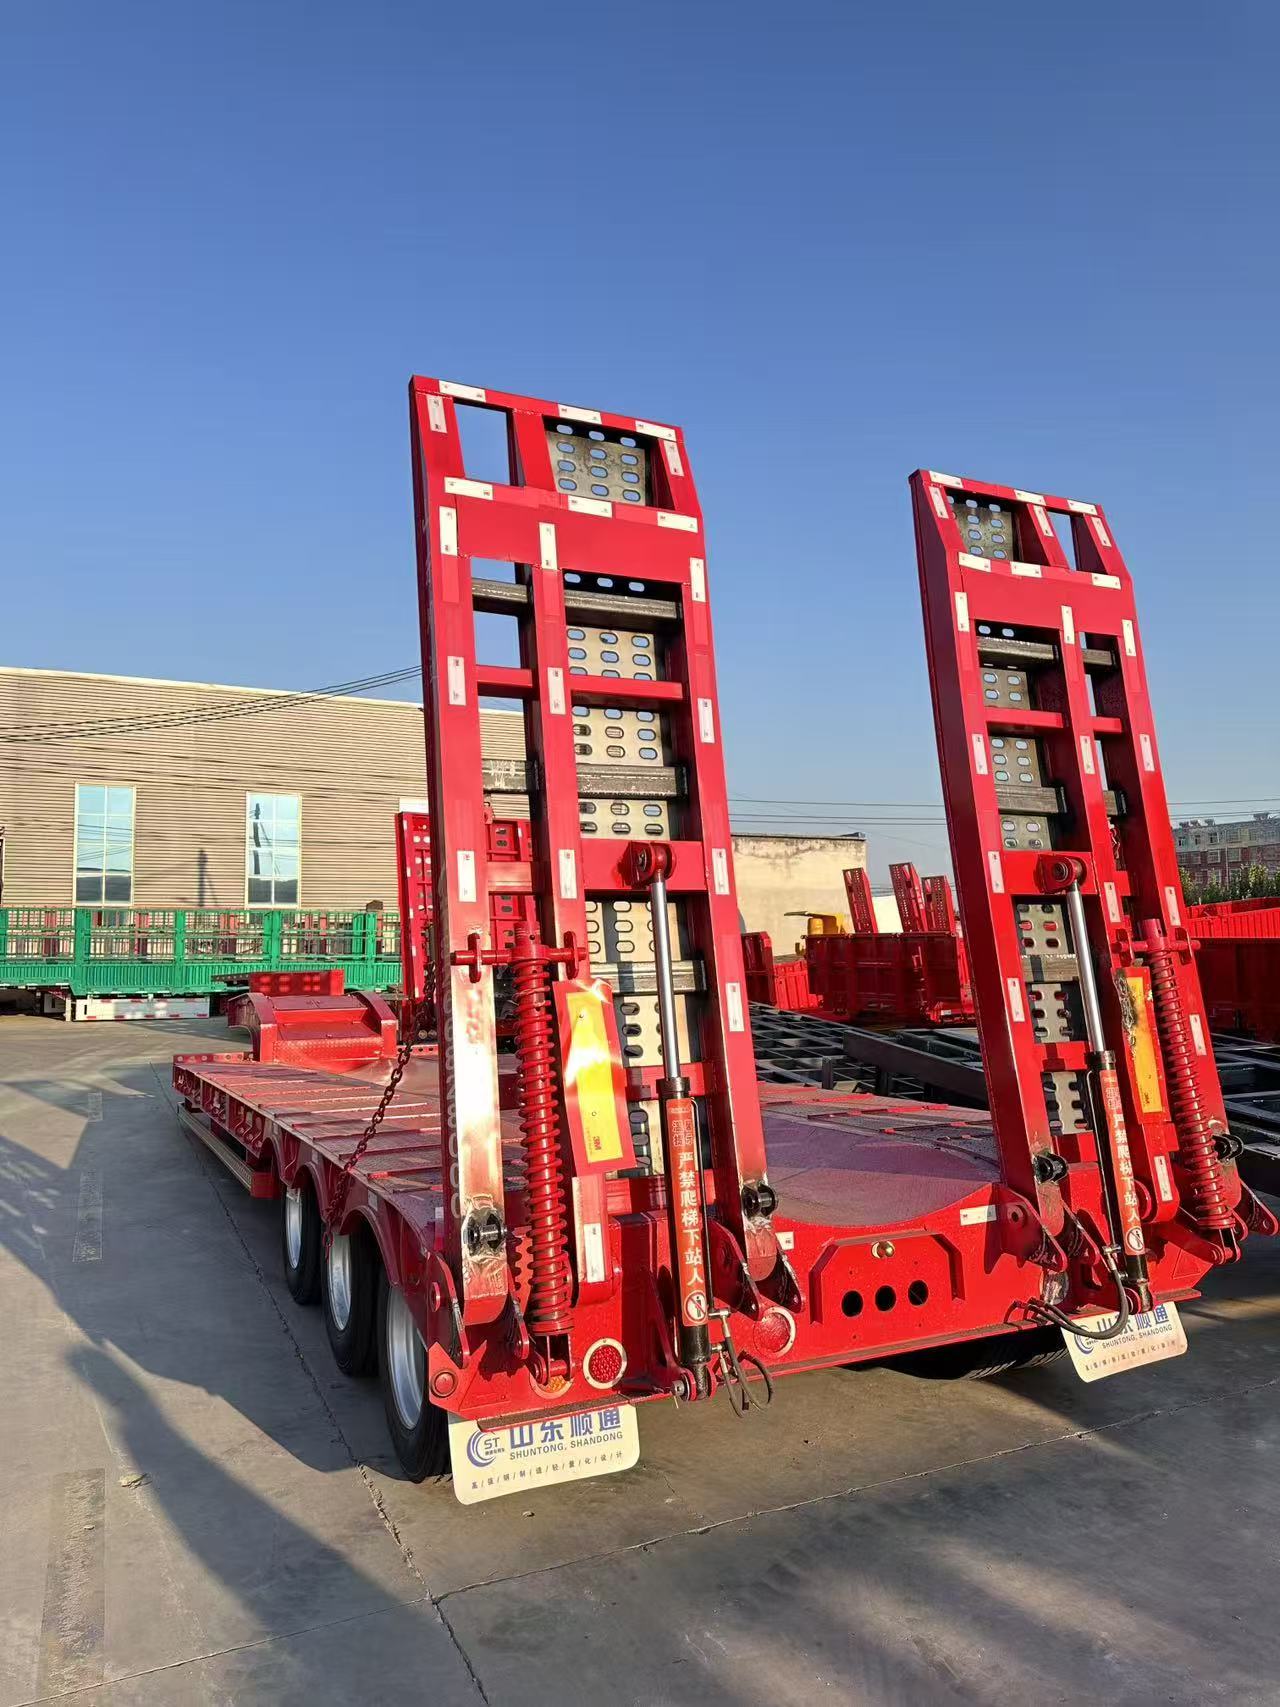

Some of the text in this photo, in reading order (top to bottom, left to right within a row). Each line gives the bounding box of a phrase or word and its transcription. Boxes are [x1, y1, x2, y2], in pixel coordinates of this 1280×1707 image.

[1113, 1113, 1141, 1223] 严禁爬梯下站人
[678, 1151, 705, 1286] 严禁爬梯下站人
[1139, 1323, 1173, 1339] SHANDONG
[484, 1437, 500, 1449] ST
[509, 1408, 621, 1449] 山东顺通
[510, 1442, 567, 1460] SHUNTONG,
[570, 1431, 623, 1449] SHANDONG
